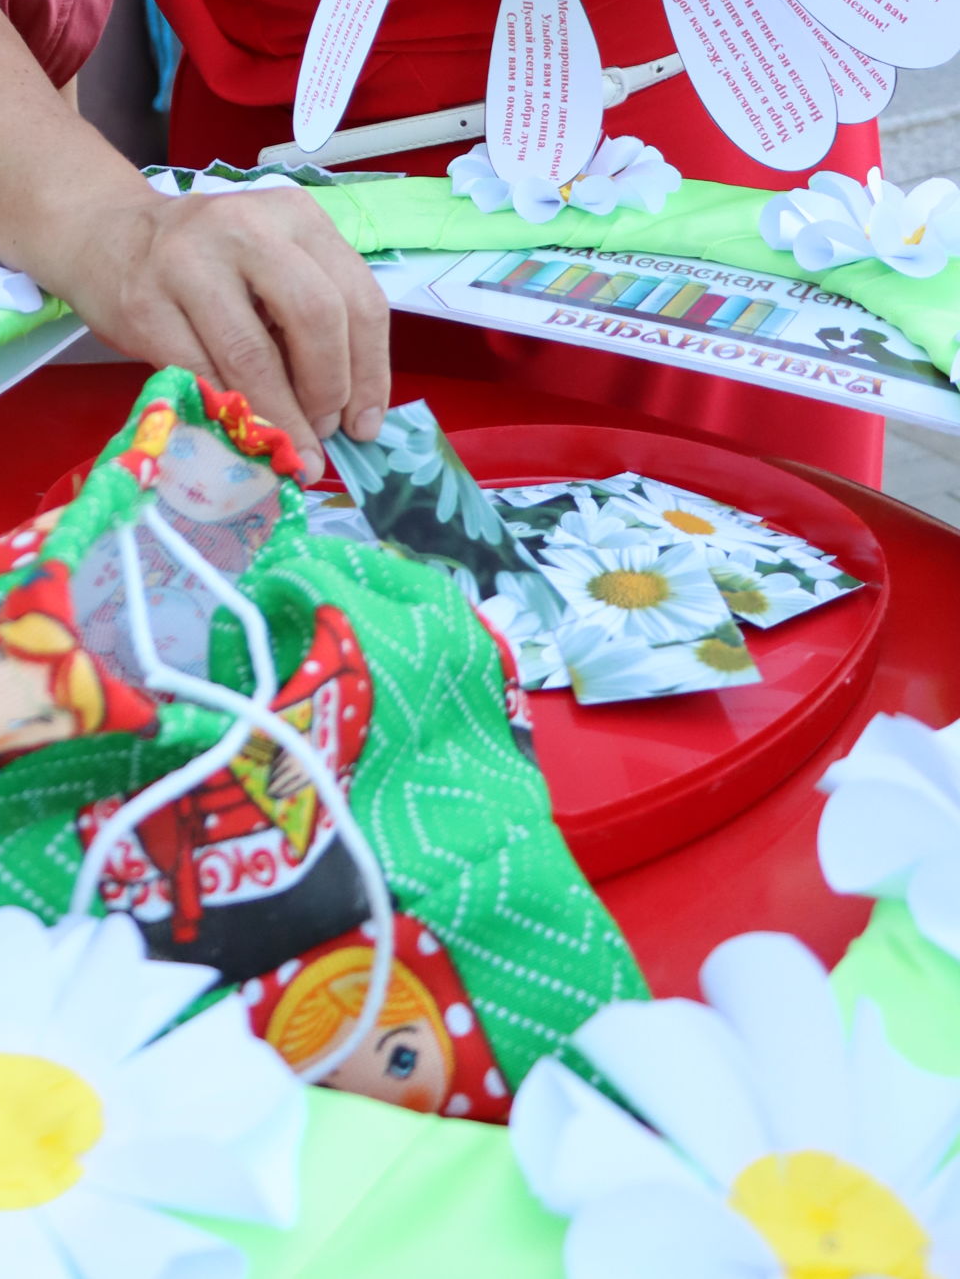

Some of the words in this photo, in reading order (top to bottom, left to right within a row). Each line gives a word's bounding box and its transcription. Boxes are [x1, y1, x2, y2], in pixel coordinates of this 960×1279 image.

[507, 12, 517, 52] Сияют
[521, 1, 535, 43] Пускай
[713, 19, 722, 27] и
[752, 10, 783, 51] узнала
[884, 3, 908, 23] вам
[541, 14, 553, 60] Улыбок
[556, 0, 569, 103] Международным
[690, 17, 723, 67] Желаем
[720, 29, 745, 61] уюта
[508, 57, 516, 80] вам
[525, 47, 534, 86] всегда
[741, 29, 788, 99] прекрасная
[741, 61, 764, 93] доме,
[778, 53, 790, 67] не
[812, 28, 839, 59] нежно
[838, 60, 871, 101] смеется.
[867, 68, 887, 90] день
[521, 90, 534, 127] добра
[717, 67, 775, 152] Поздравляем!
[761, 96, 769, 104] в
[788, 69, 823, 122] Никогда
[502, 96, 515, 145] оконце!
[557, 106, 567, 138] днем
[767, 106, 791, 143] Мира
[783, 102, 805, 133] Чтоб
[517, 132, 528, 161] лучи
[547, 307, 888, 398] БИБЛИОТЕКА
